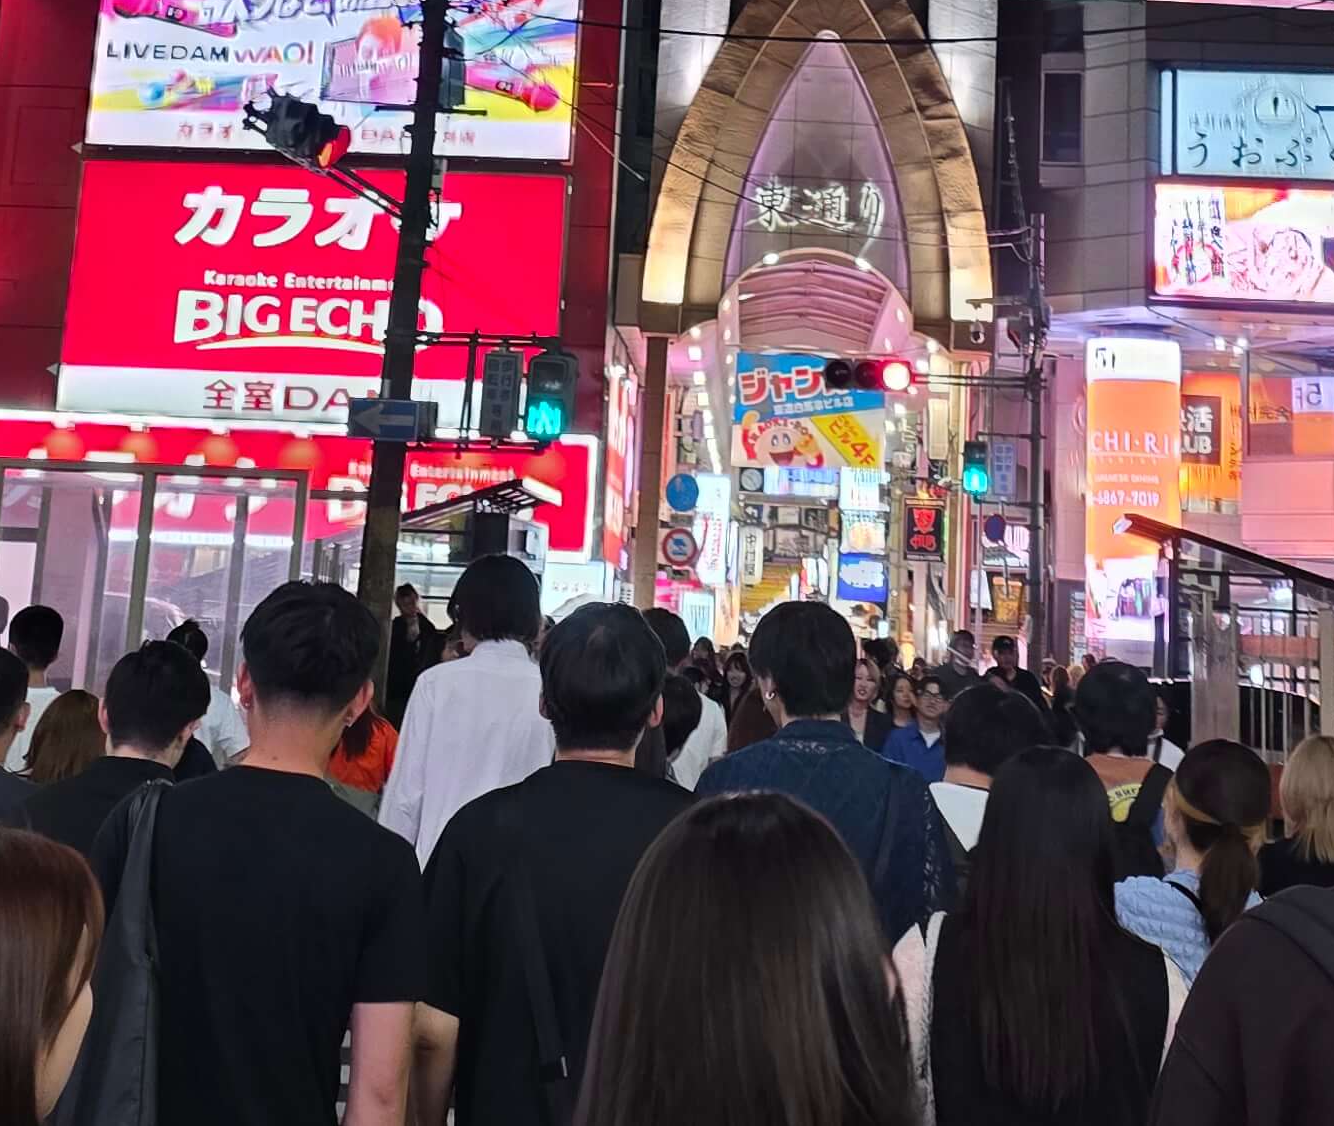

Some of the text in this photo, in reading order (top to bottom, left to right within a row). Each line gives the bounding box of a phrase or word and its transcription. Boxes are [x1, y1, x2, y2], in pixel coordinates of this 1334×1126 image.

[106, 39, 228, 63] LIVEDAM
[744, 173, 884, 258] 東通り
[203, 269, 396, 291] Karaoke Entertainm
[173, 290, 281, 344] BIG
[203, 378, 379, 412] 全室DA
